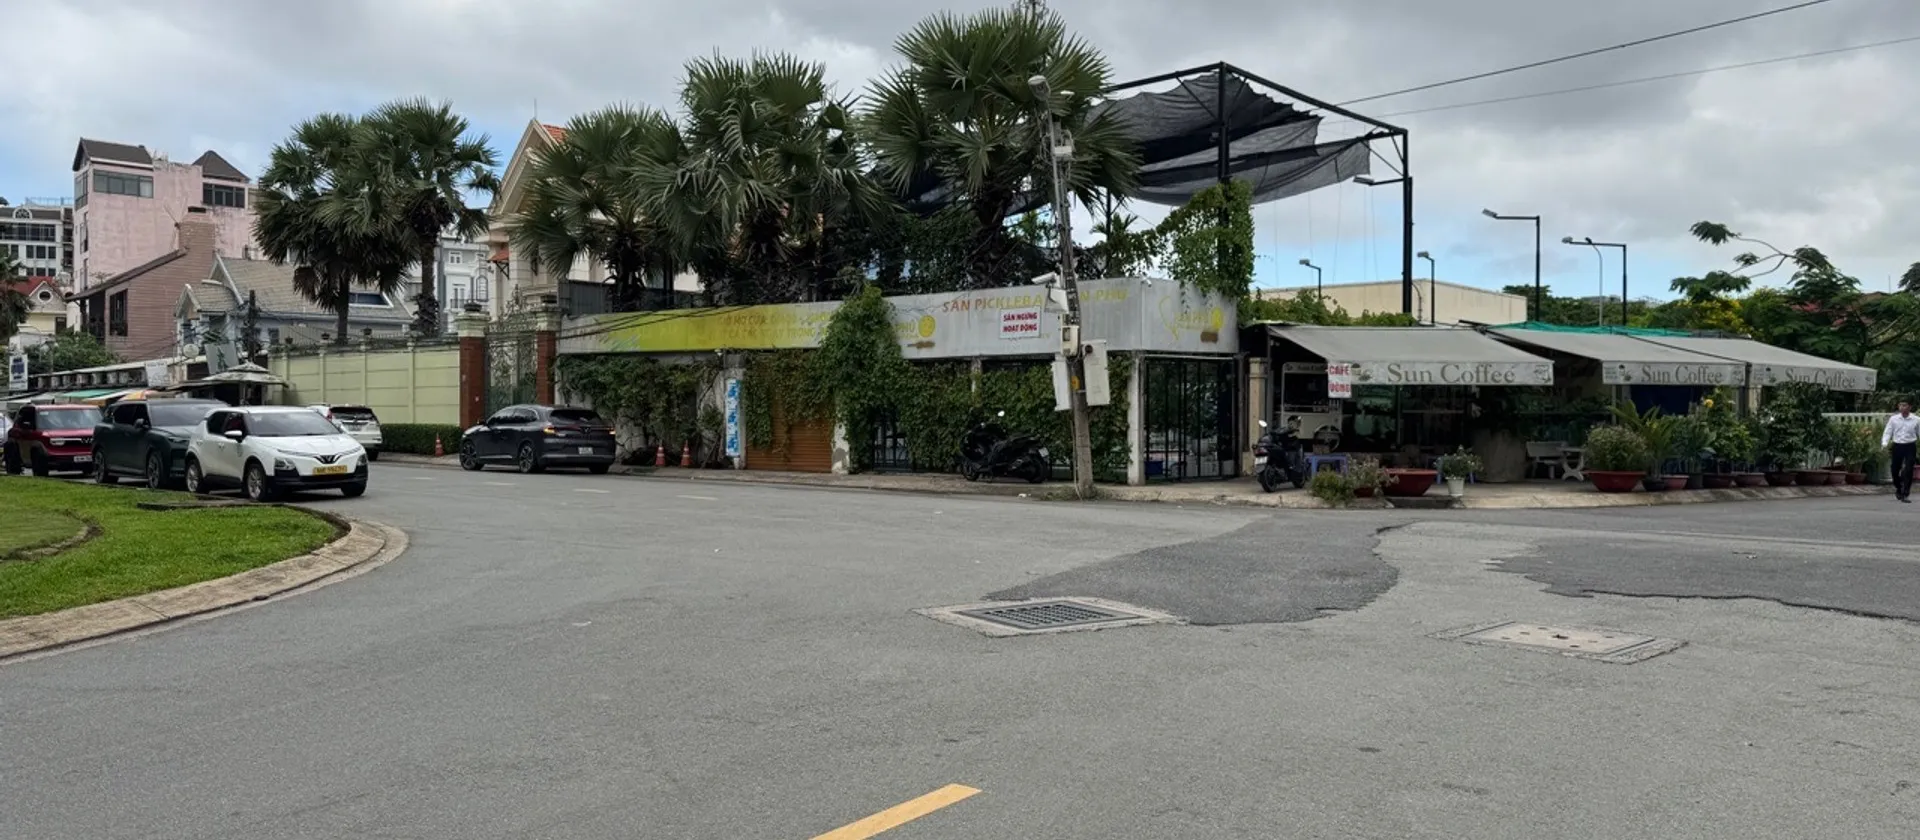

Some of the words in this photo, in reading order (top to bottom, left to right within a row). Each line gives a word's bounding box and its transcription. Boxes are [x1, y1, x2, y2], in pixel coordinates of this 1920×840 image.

[1387, 363, 1432, 383] Sun
[1440, 363, 1515, 384] Coffee
[1641, 365, 1671, 383] Sun
[1675, 364, 1723, 384] Coffee
[1785, 367, 1810, 382] Sun
[1814, 368, 1855, 388] Coffee
